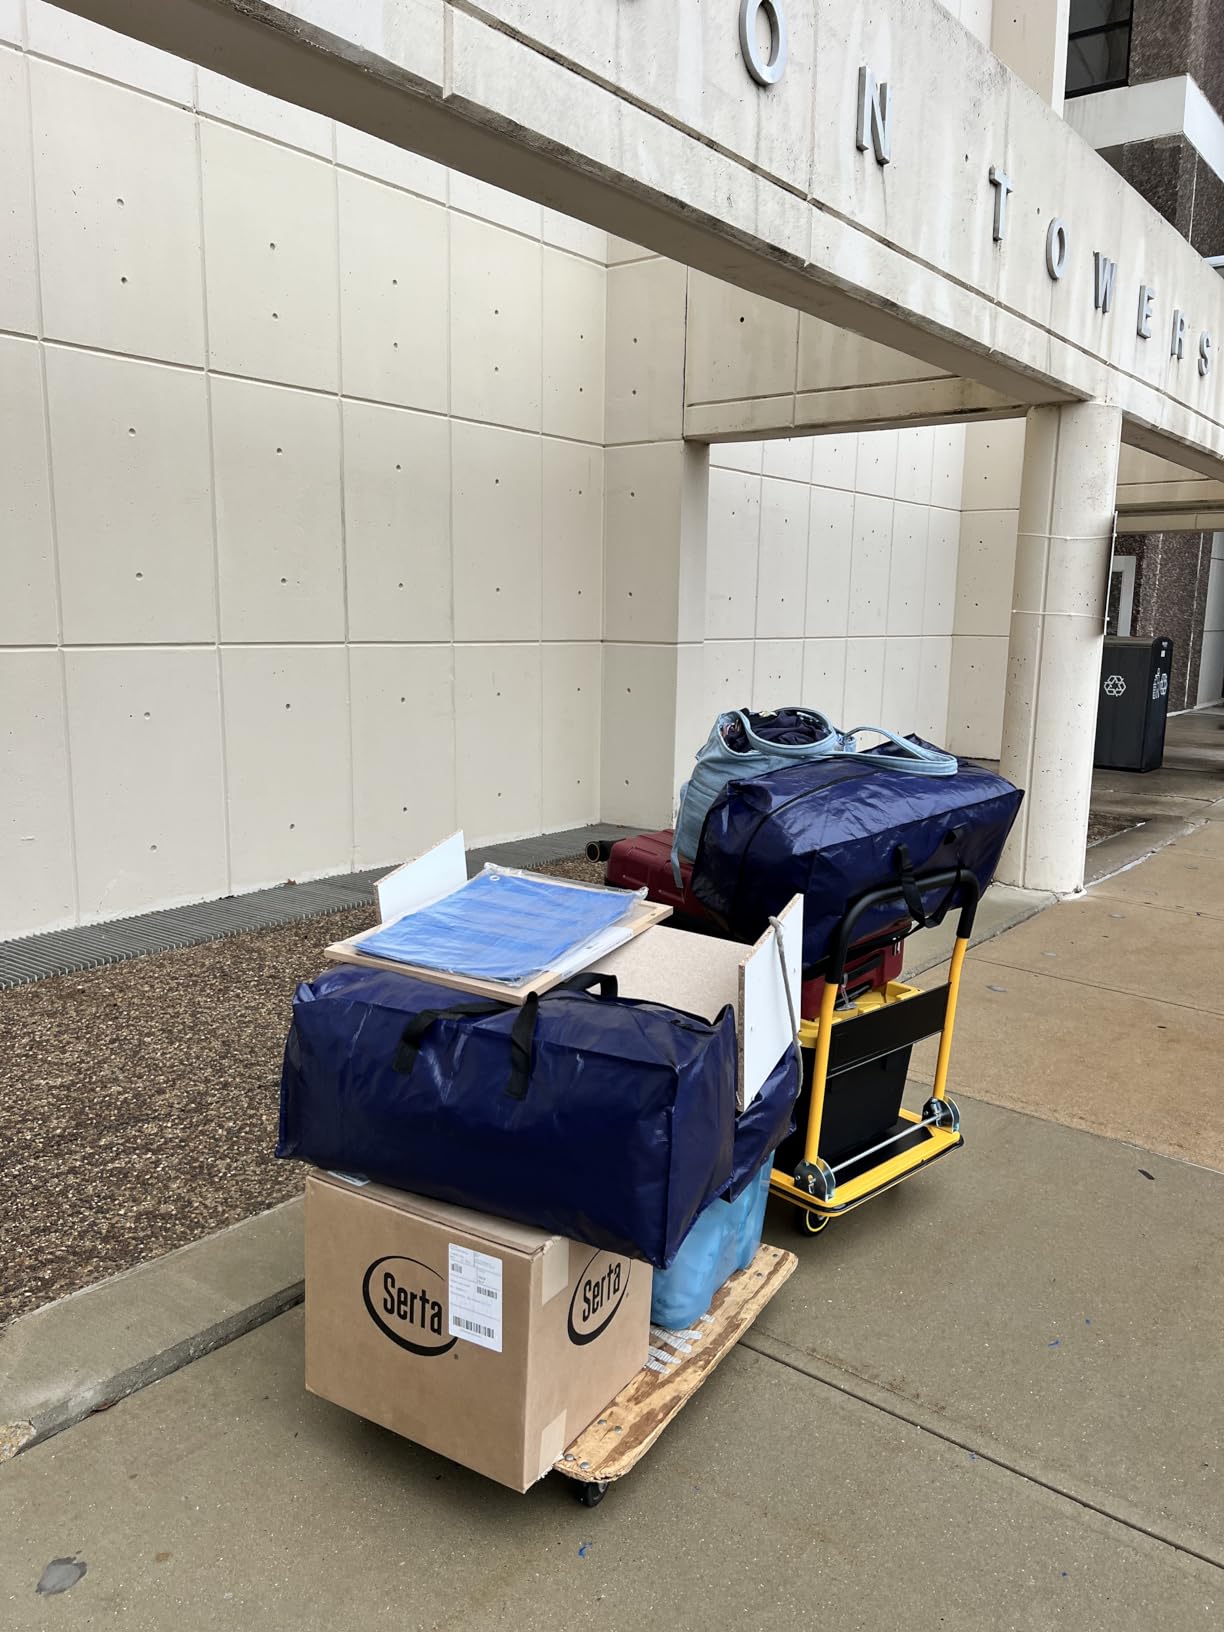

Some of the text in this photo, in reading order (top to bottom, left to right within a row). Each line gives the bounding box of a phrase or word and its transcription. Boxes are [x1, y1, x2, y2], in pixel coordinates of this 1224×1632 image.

[988, 165, 1212, 377] TOWERS
[383, 1272, 442, 1335] Serta
[582, 1261, 621, 1322] Serta
